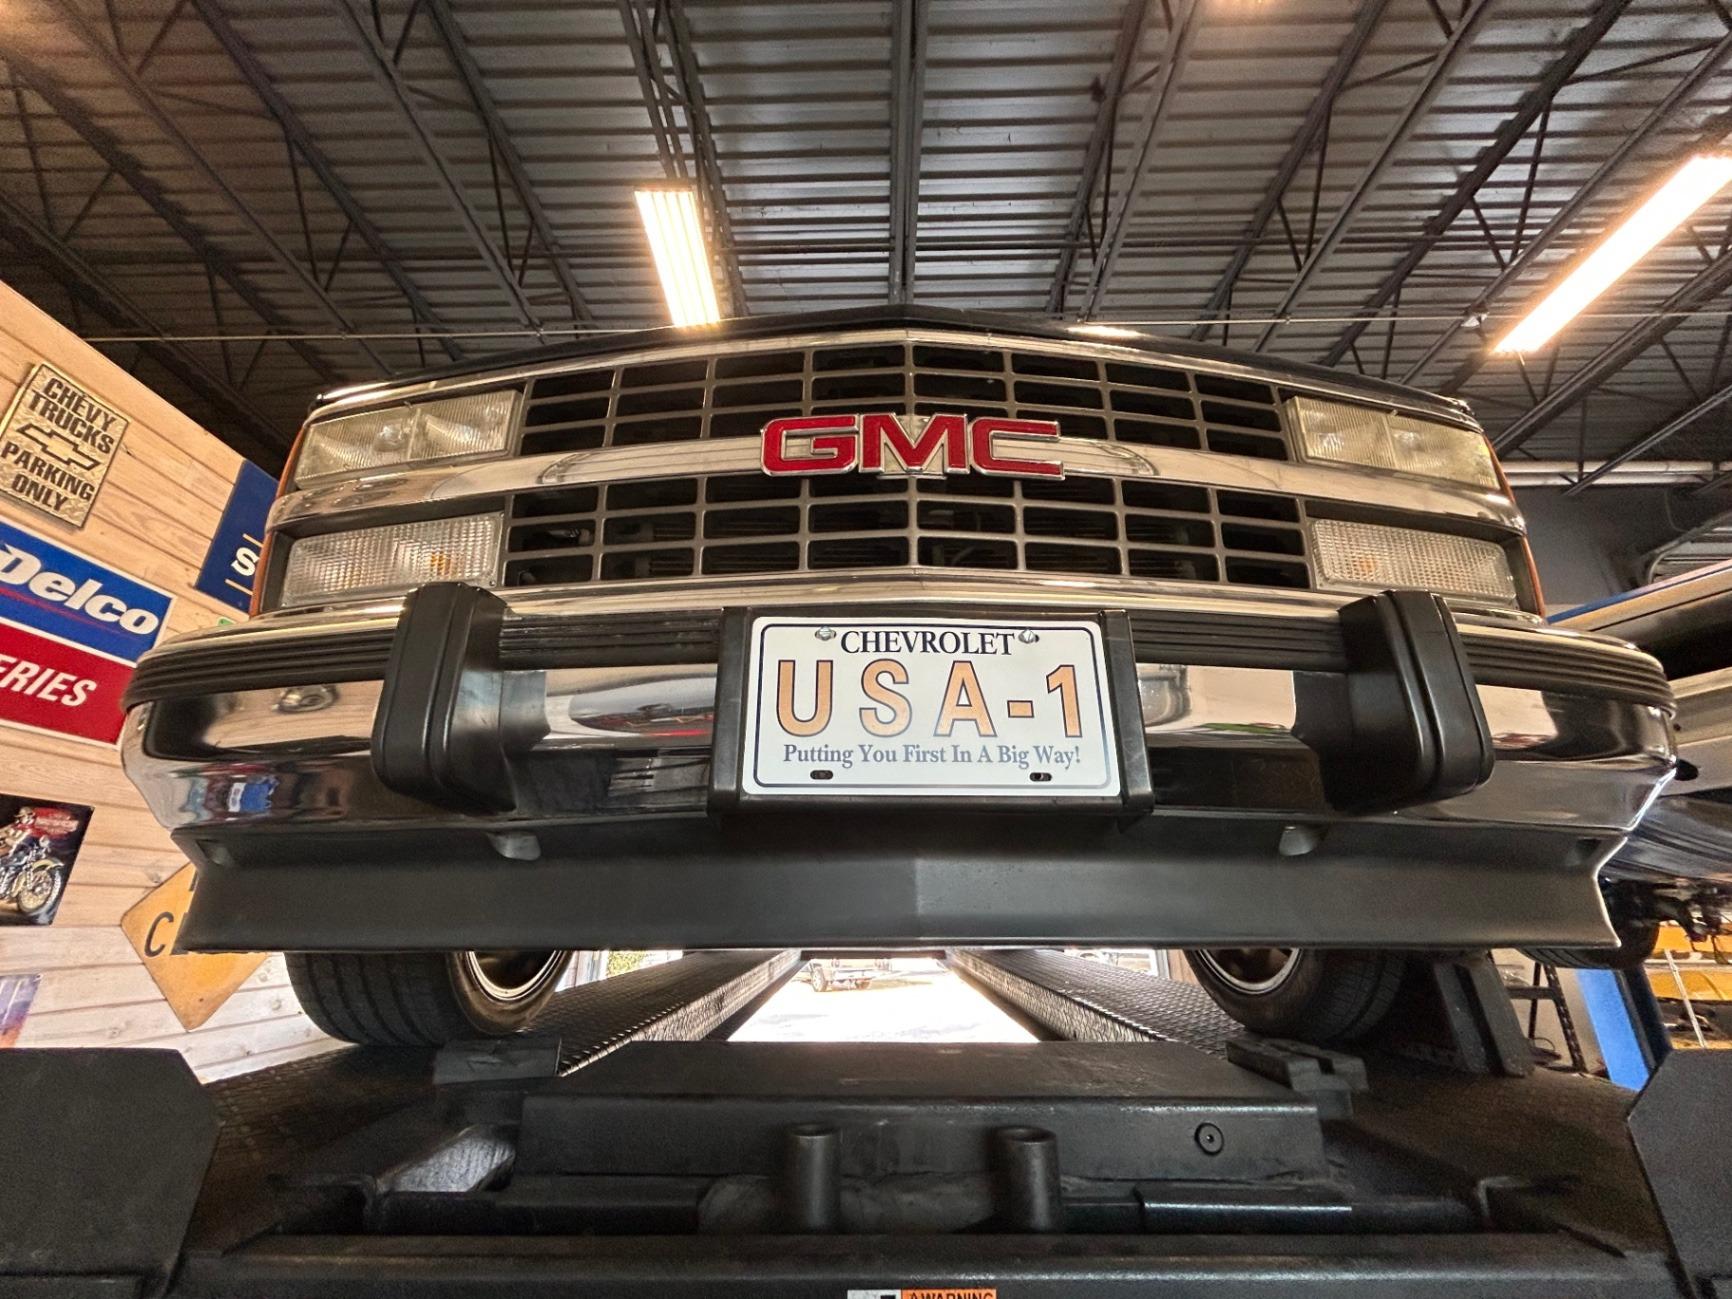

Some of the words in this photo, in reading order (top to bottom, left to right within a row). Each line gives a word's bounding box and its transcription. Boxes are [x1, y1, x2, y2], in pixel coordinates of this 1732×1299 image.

[28, 389, 115, 454] TRUCKS
[43, 377, 117, 432] CHEVY
[1, 440, 95, 500] PARKING
[760, 412, 1066, 480] GMC
[11, 473, 69, 512] ONLY
[0, 543, 159, 635] Delco
[840, 630, 1015, 656] CHEVROLET
[783, 744, 853, 769] Putting
[858, 744, 897, 763] You
[902, 744, 947, 763] First
[952, 744, 972, 763] In
[977, 745, 993, 763] A
[999, 745, 1029, 770] Big
[1033, 745, 1081, 770] Way!
